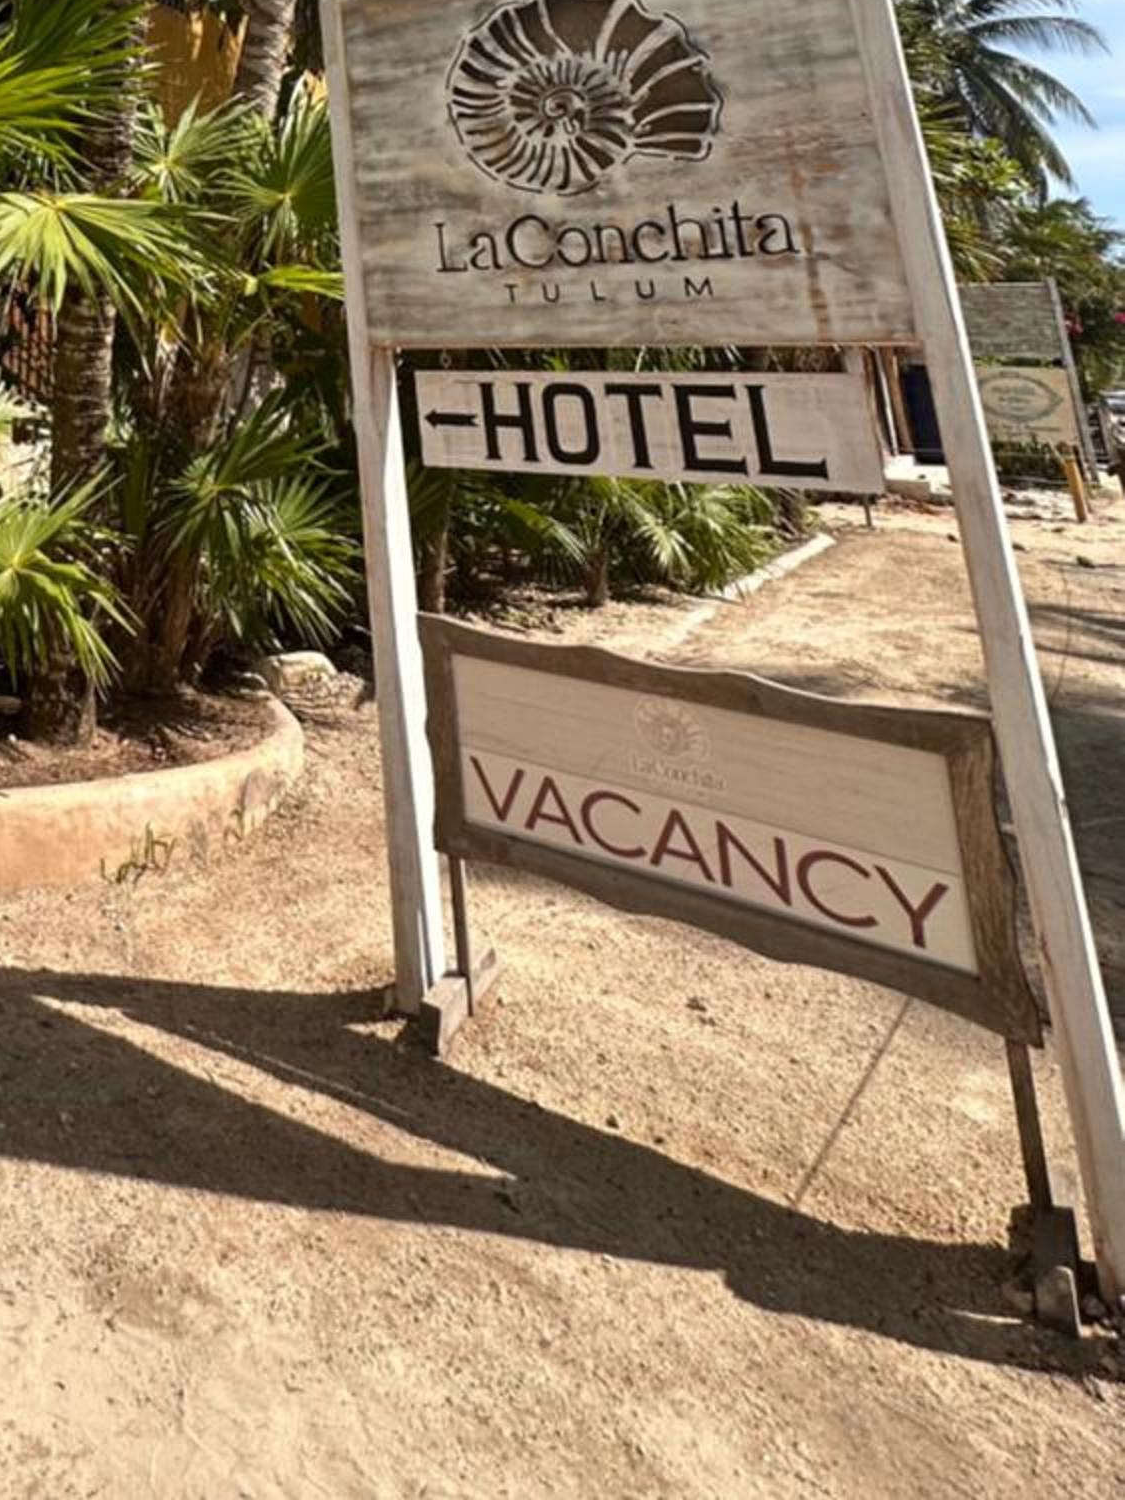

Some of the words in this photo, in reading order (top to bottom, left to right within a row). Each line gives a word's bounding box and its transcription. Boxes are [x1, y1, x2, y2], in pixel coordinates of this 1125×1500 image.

[504, 276, 714, 302] TULUM
[478, 382, 829, 480] HOTEL
[470, 756, 949, 948] VACANCY
